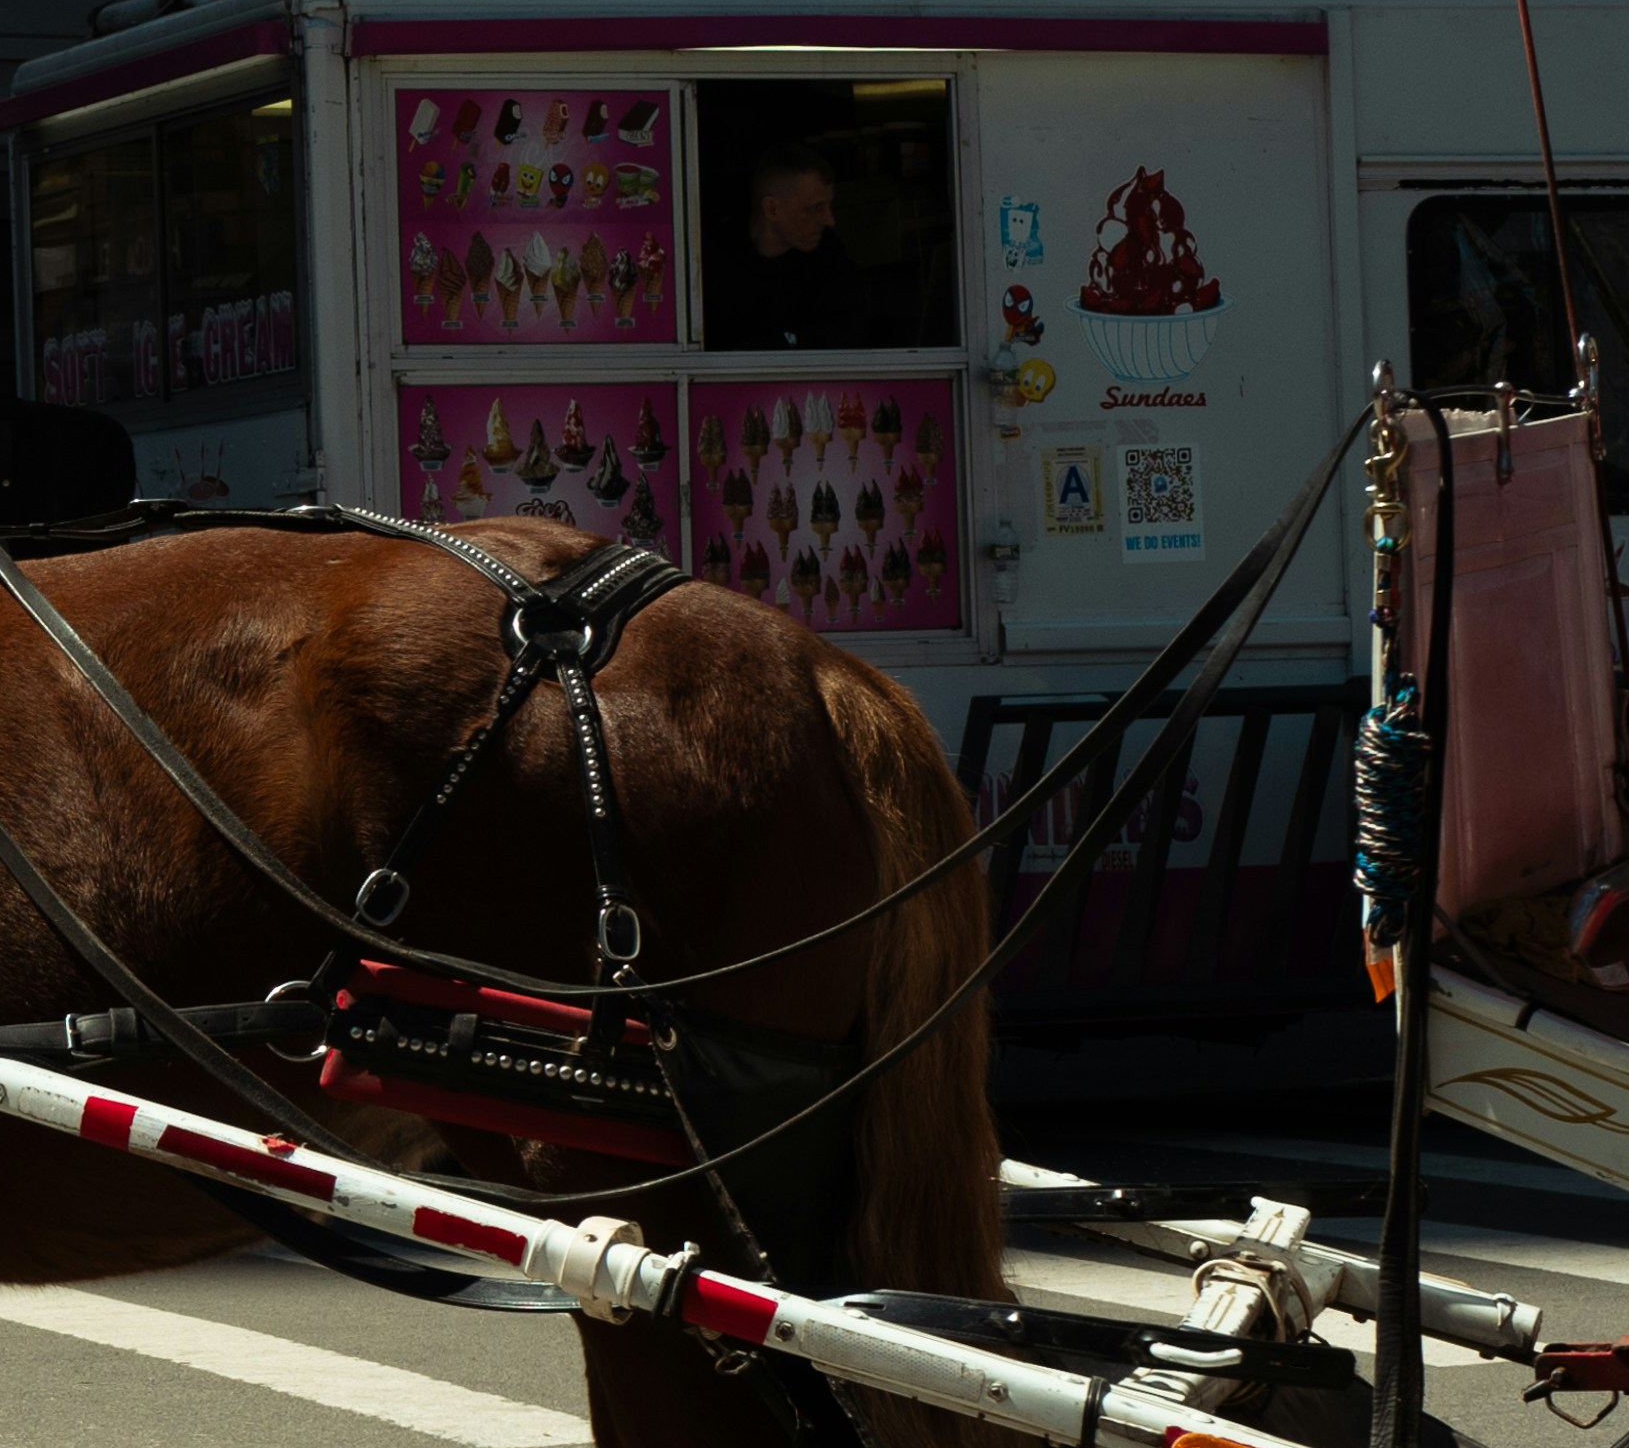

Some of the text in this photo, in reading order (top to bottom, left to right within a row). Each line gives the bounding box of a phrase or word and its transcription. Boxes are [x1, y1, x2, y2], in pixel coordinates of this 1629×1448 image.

[43, 327, 107, 408] SOFT
[202, 290, 296, 386] CREAM
[1099, 385, 1208, 410] Sundaes
[1058, 465, 1090, 505] A
[1125, 534, 1202, 550] WE DO EVENTS!
[1102, 850, 1135, 870] DIESEL
